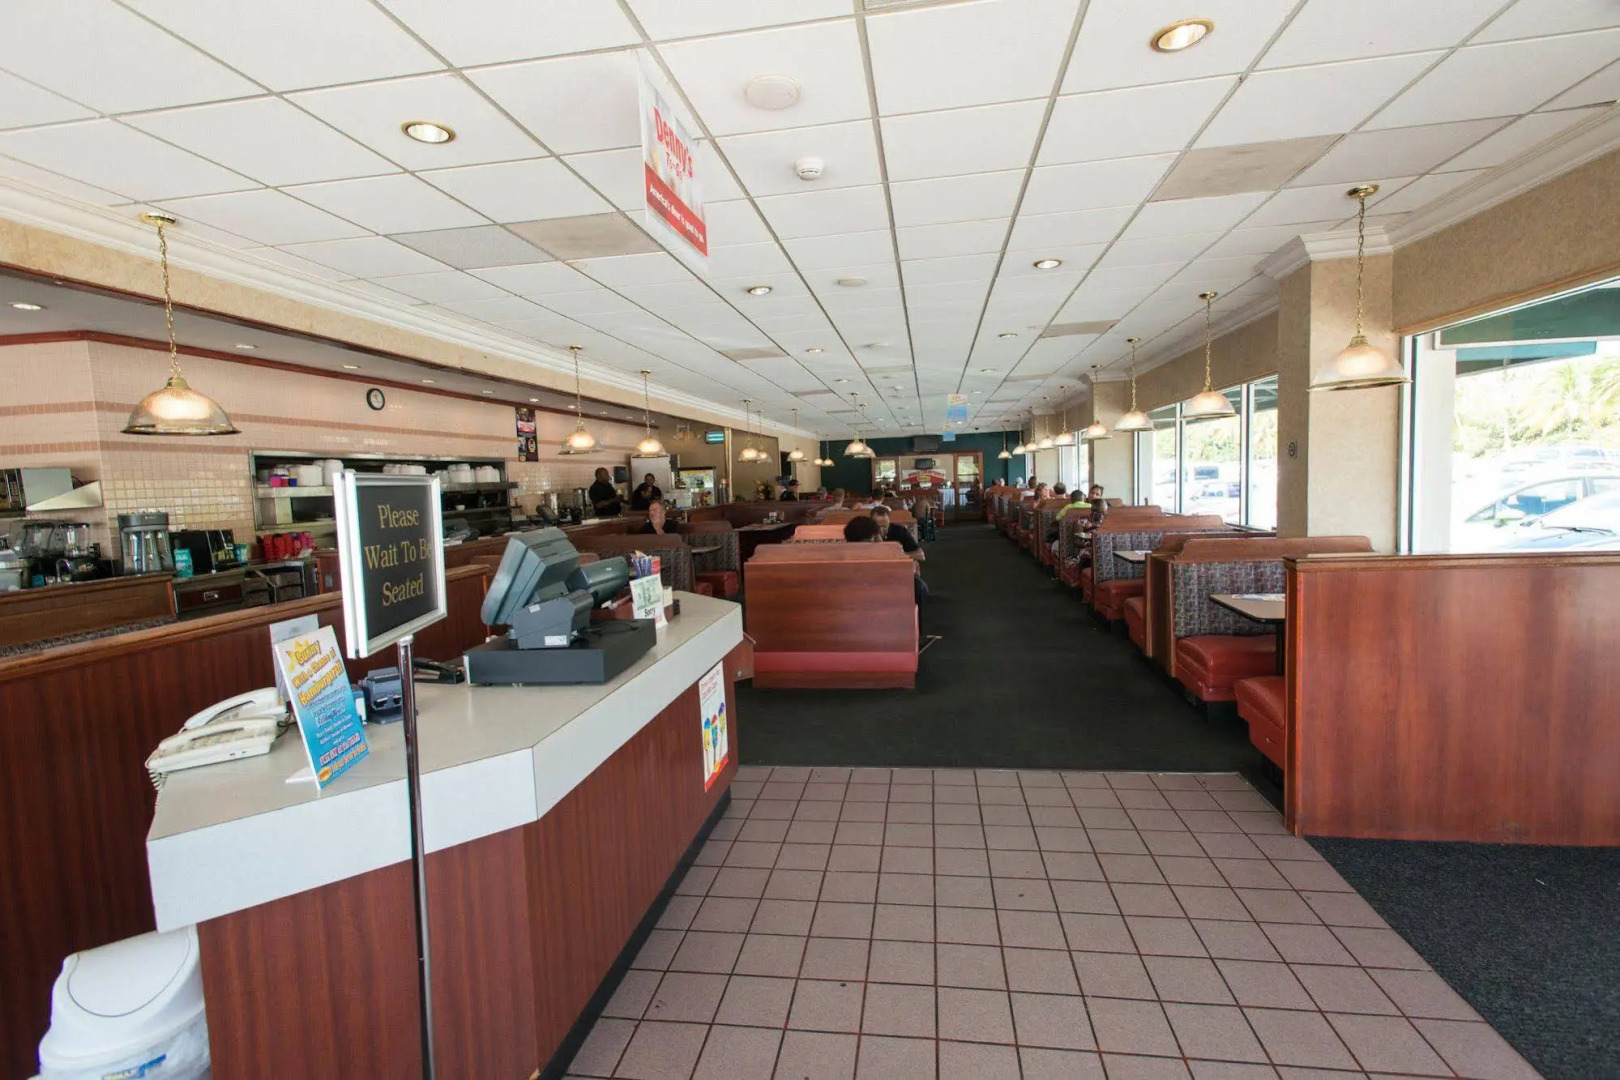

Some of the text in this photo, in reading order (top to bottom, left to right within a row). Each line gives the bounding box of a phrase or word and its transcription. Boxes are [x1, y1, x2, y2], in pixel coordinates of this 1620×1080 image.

[653, 106, 692, 178] Denny's
[377, 505, 420, 529] Please
[364, 538, 431, 570] Wait To Be
[382, 573, 424, 607] Seated
[295, 639, 322, 666] Sunny
